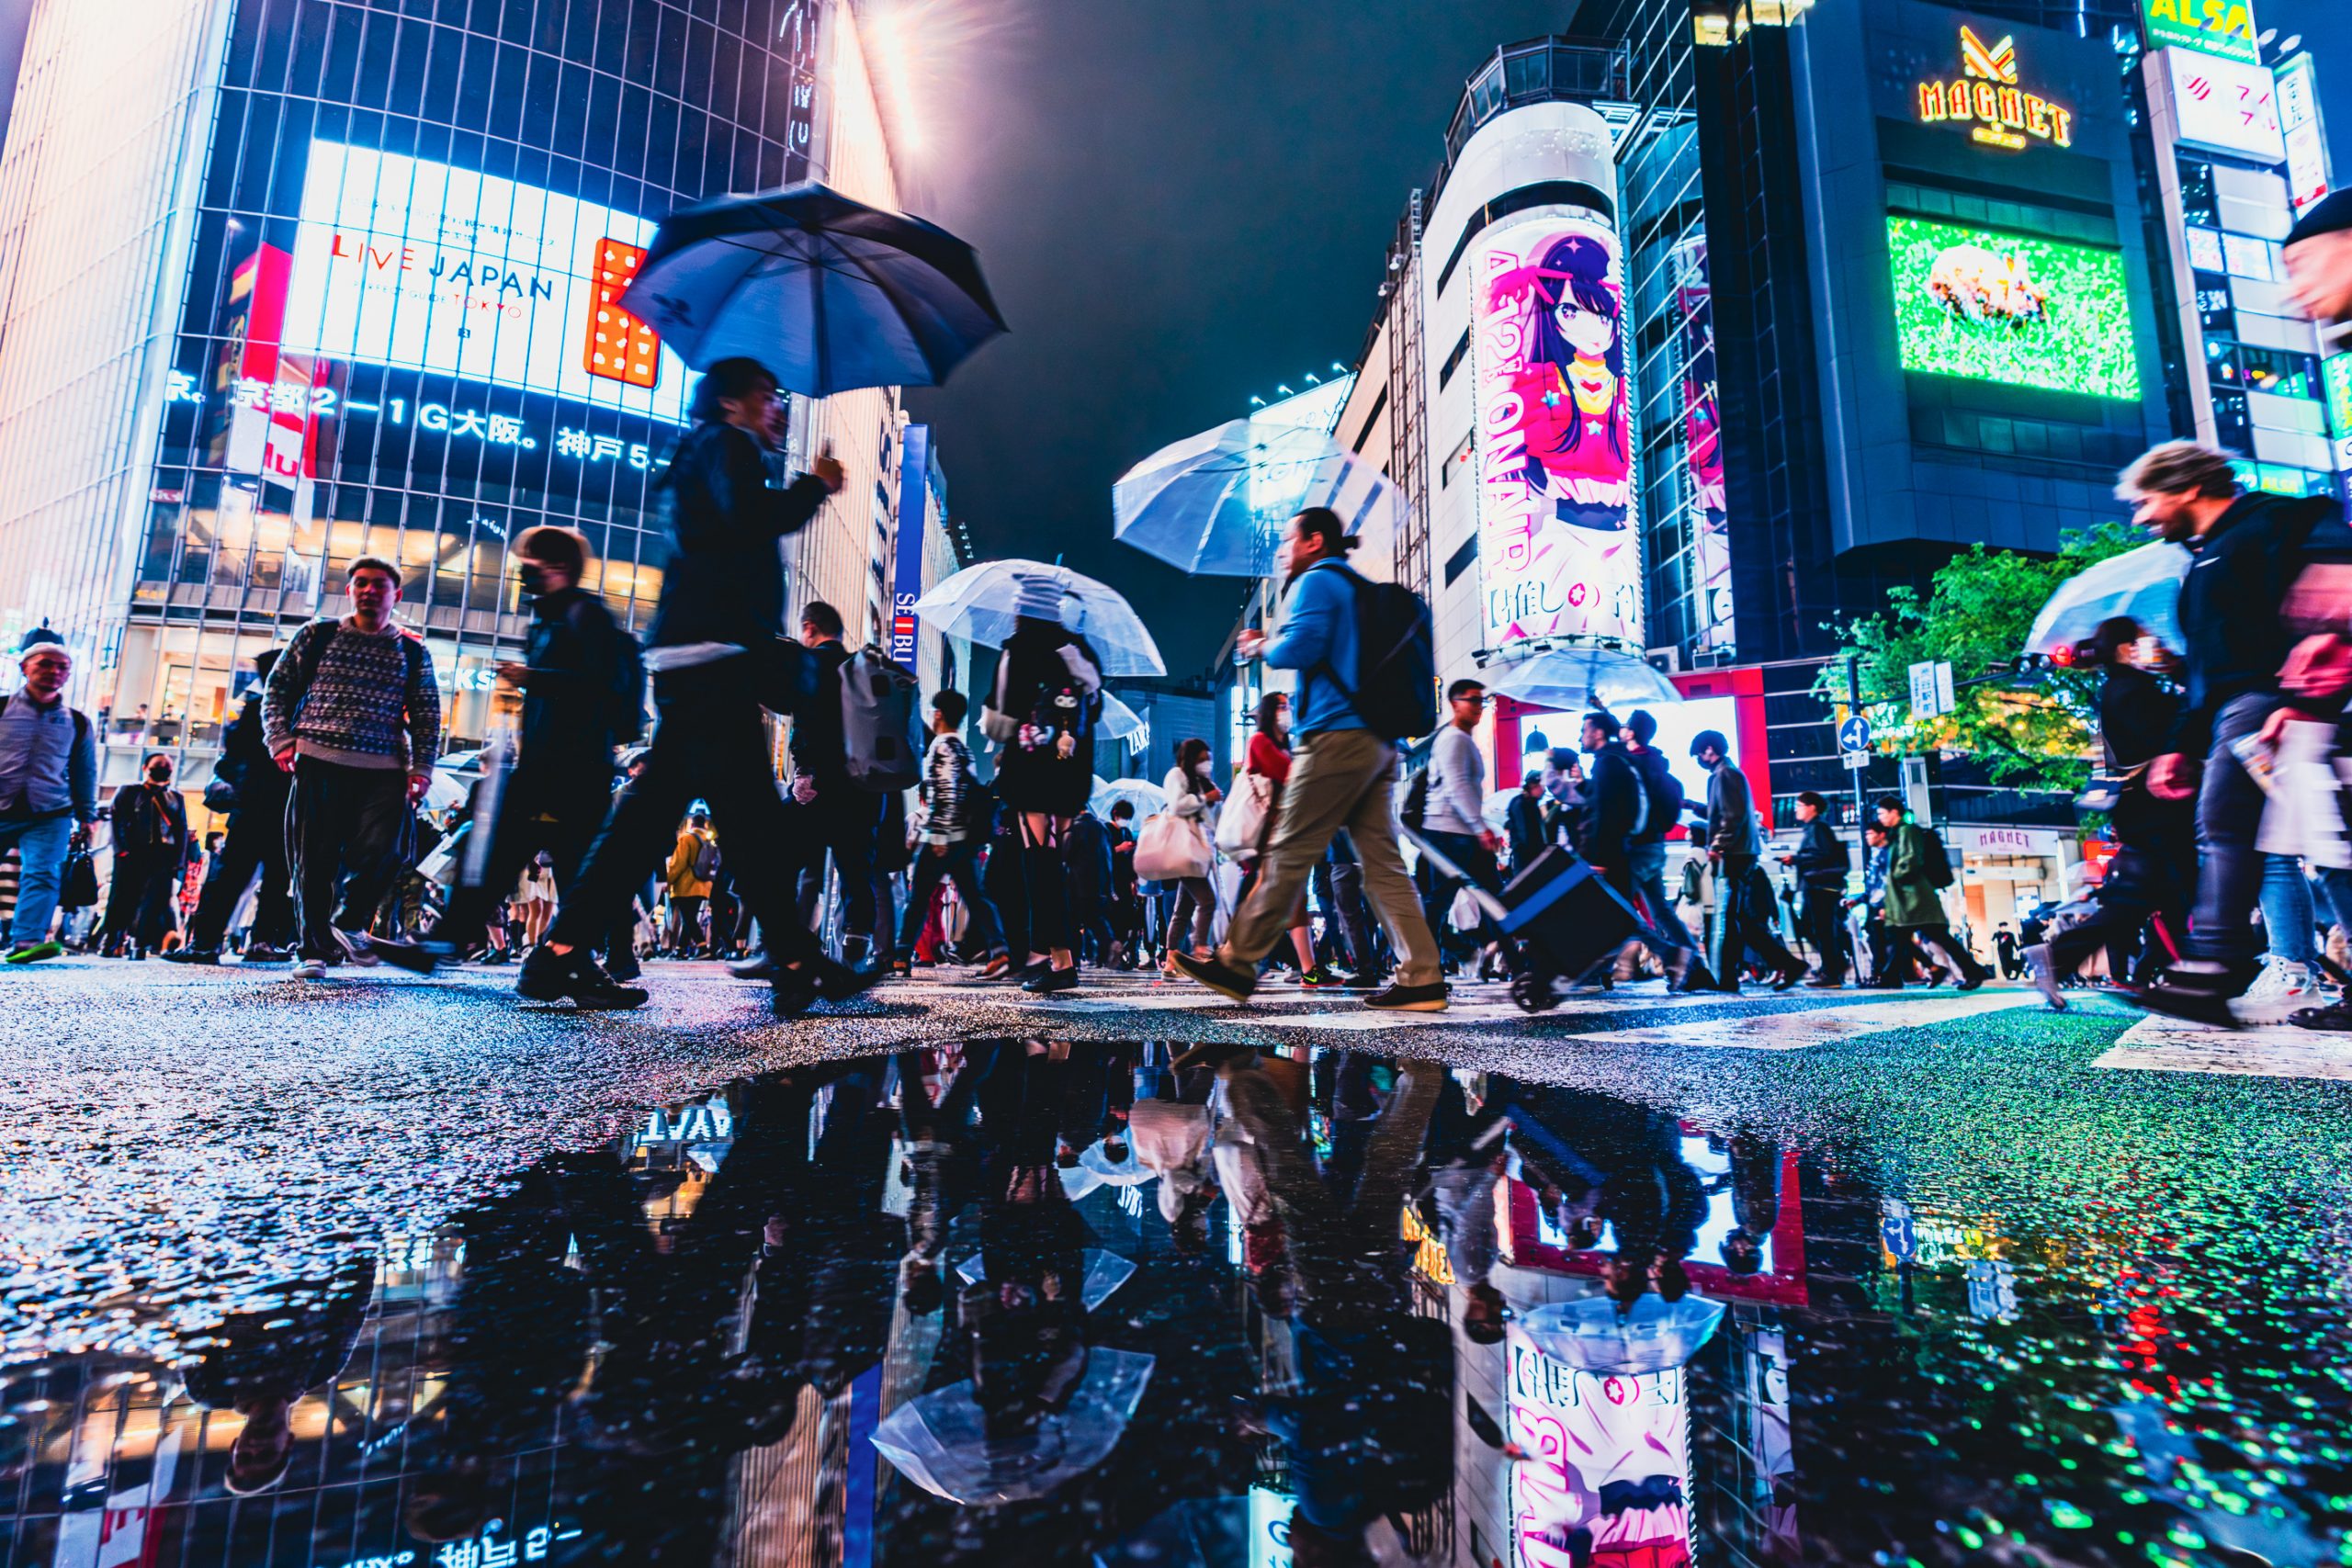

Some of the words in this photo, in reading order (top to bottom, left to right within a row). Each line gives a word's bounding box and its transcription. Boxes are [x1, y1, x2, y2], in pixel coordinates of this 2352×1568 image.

[1919, 80, 2071, 147] MAGNET
[332, 234, 415, 272] LIVE
[429, 256, 552, 301] JAPAN
[1979, 829, 2030, 848] MAGNET
